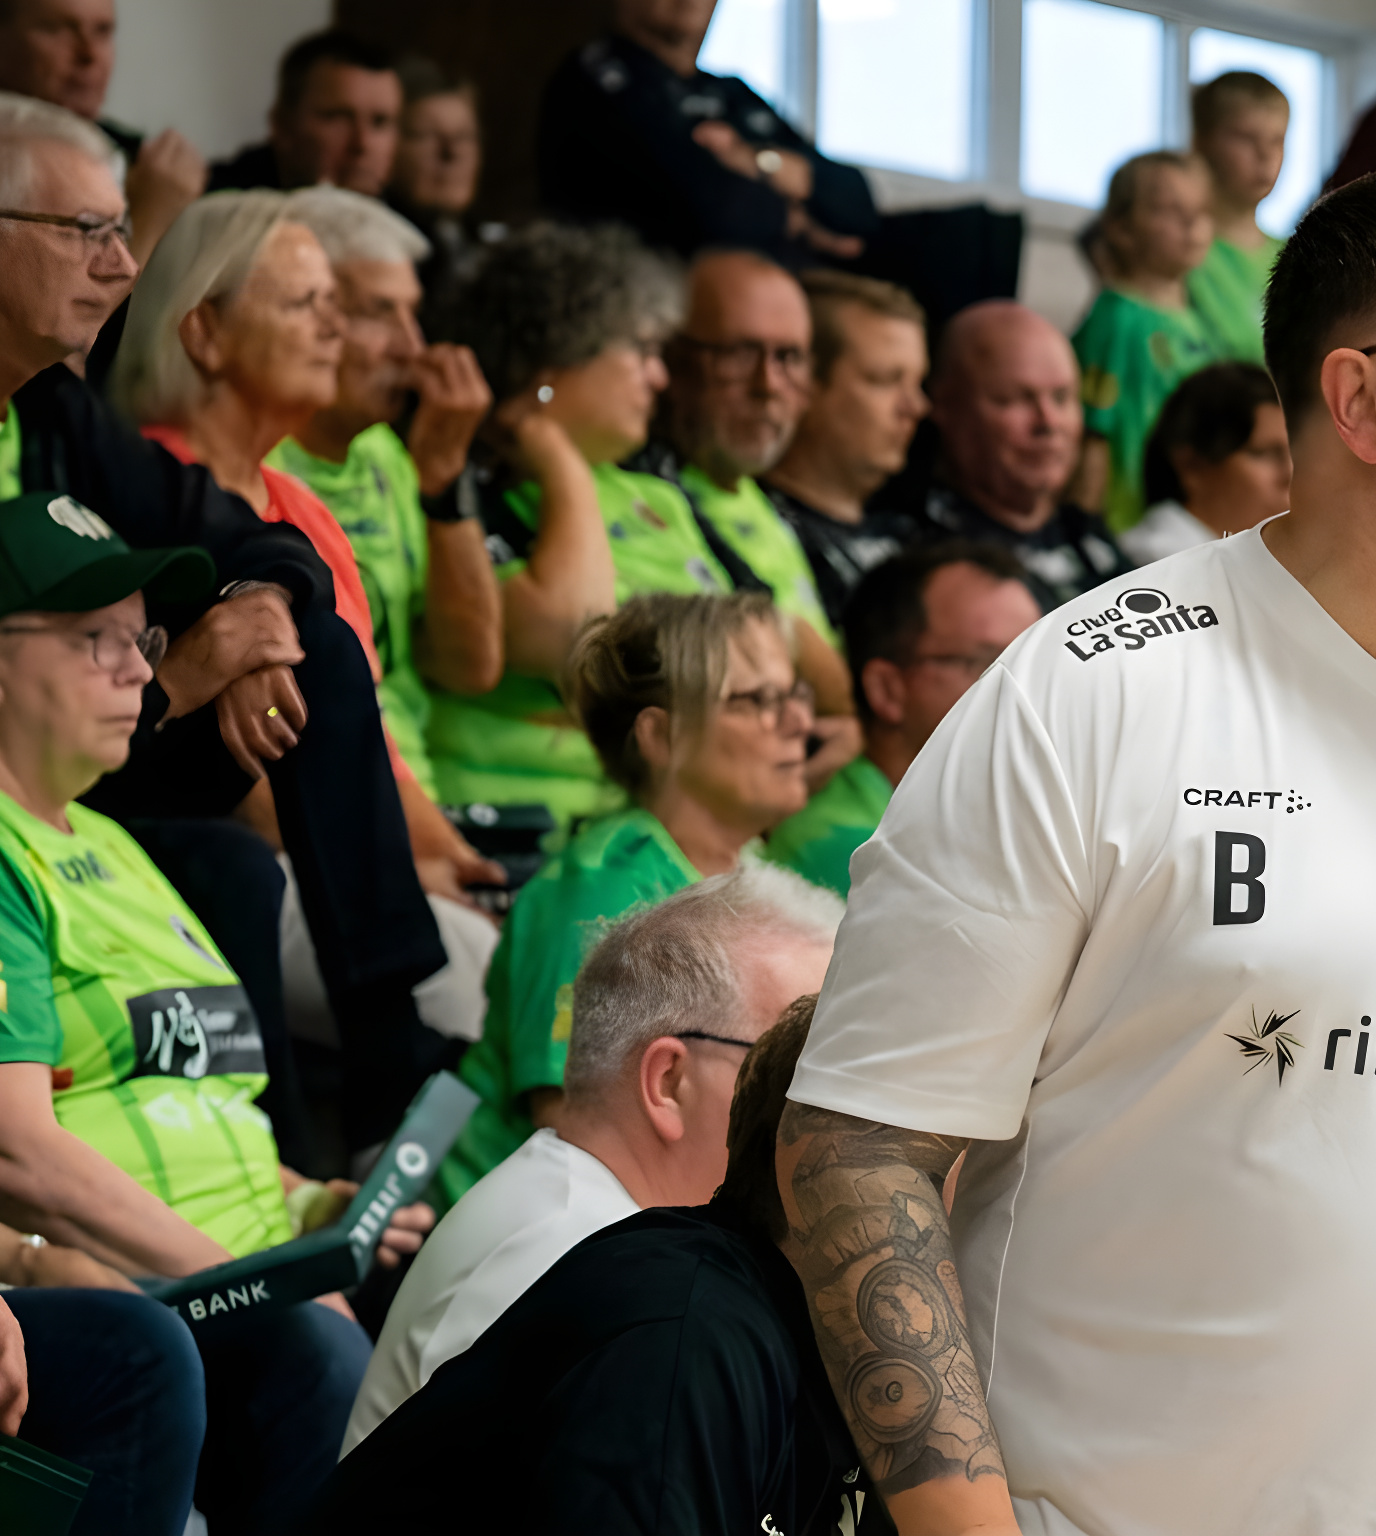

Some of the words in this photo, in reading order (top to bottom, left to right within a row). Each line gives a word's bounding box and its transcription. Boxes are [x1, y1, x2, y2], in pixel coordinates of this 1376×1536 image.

[1064, 633, 1116, 662] La
[1113, 605, 1220, 651] Santa
[1183, 788, 1283, 810] CRAFT
[1213, 830, 1266, 926] B
[188, 1279, 272, 1322] BANK
